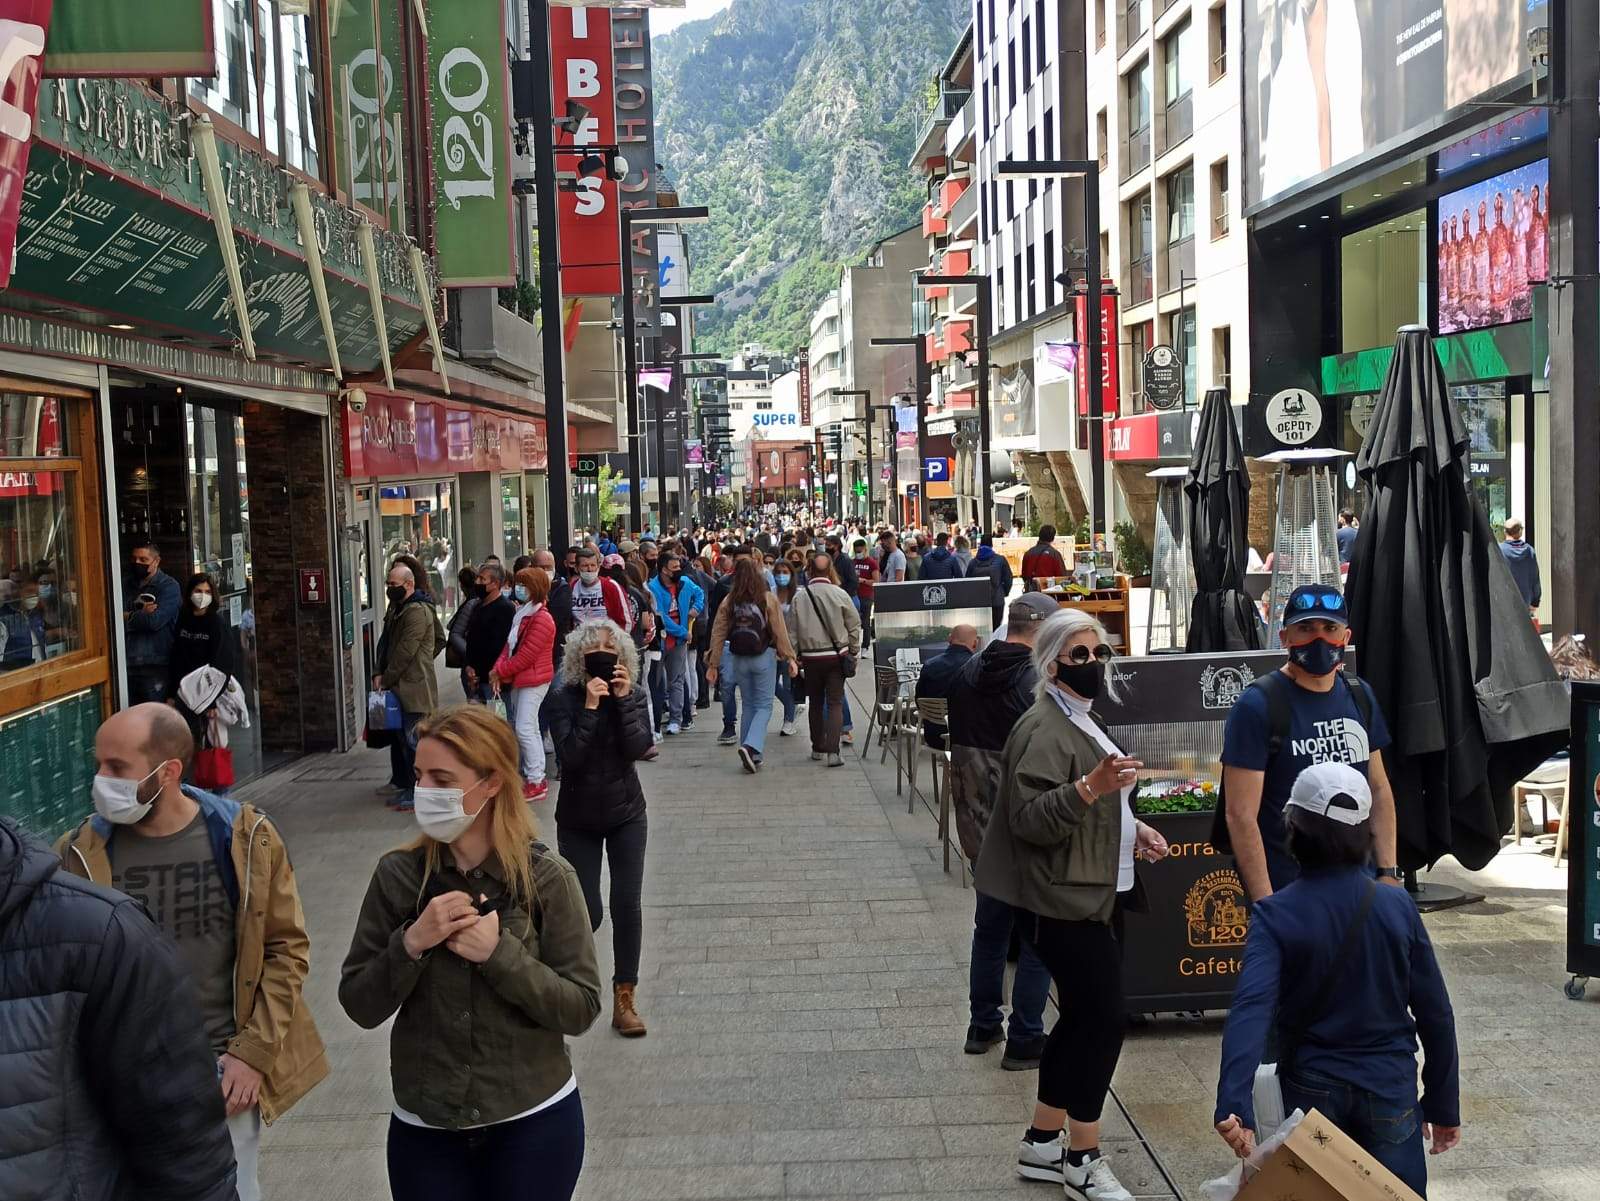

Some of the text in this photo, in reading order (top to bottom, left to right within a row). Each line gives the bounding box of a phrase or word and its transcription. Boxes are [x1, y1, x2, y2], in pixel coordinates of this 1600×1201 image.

[438, 46, 496, 211] 120
[75, 194, 116, 219] PIZZES
[0, 315, 31, 346] ADOR
[42, 323, 99, 357] GRAELLADA
[753, 413, 796, 426] SUPER
[1277, 420, 1312, 433] DEPOT
[1285, 432, 1304, 441] 101
[928, 461, 943, 479] P
[1313, 719, 1345, 737] THE
[1291, 733, 1348, 756] NORTH
[1312, 750, 1351, 765] FACE
[1207, 925, 1246, 940] 120
